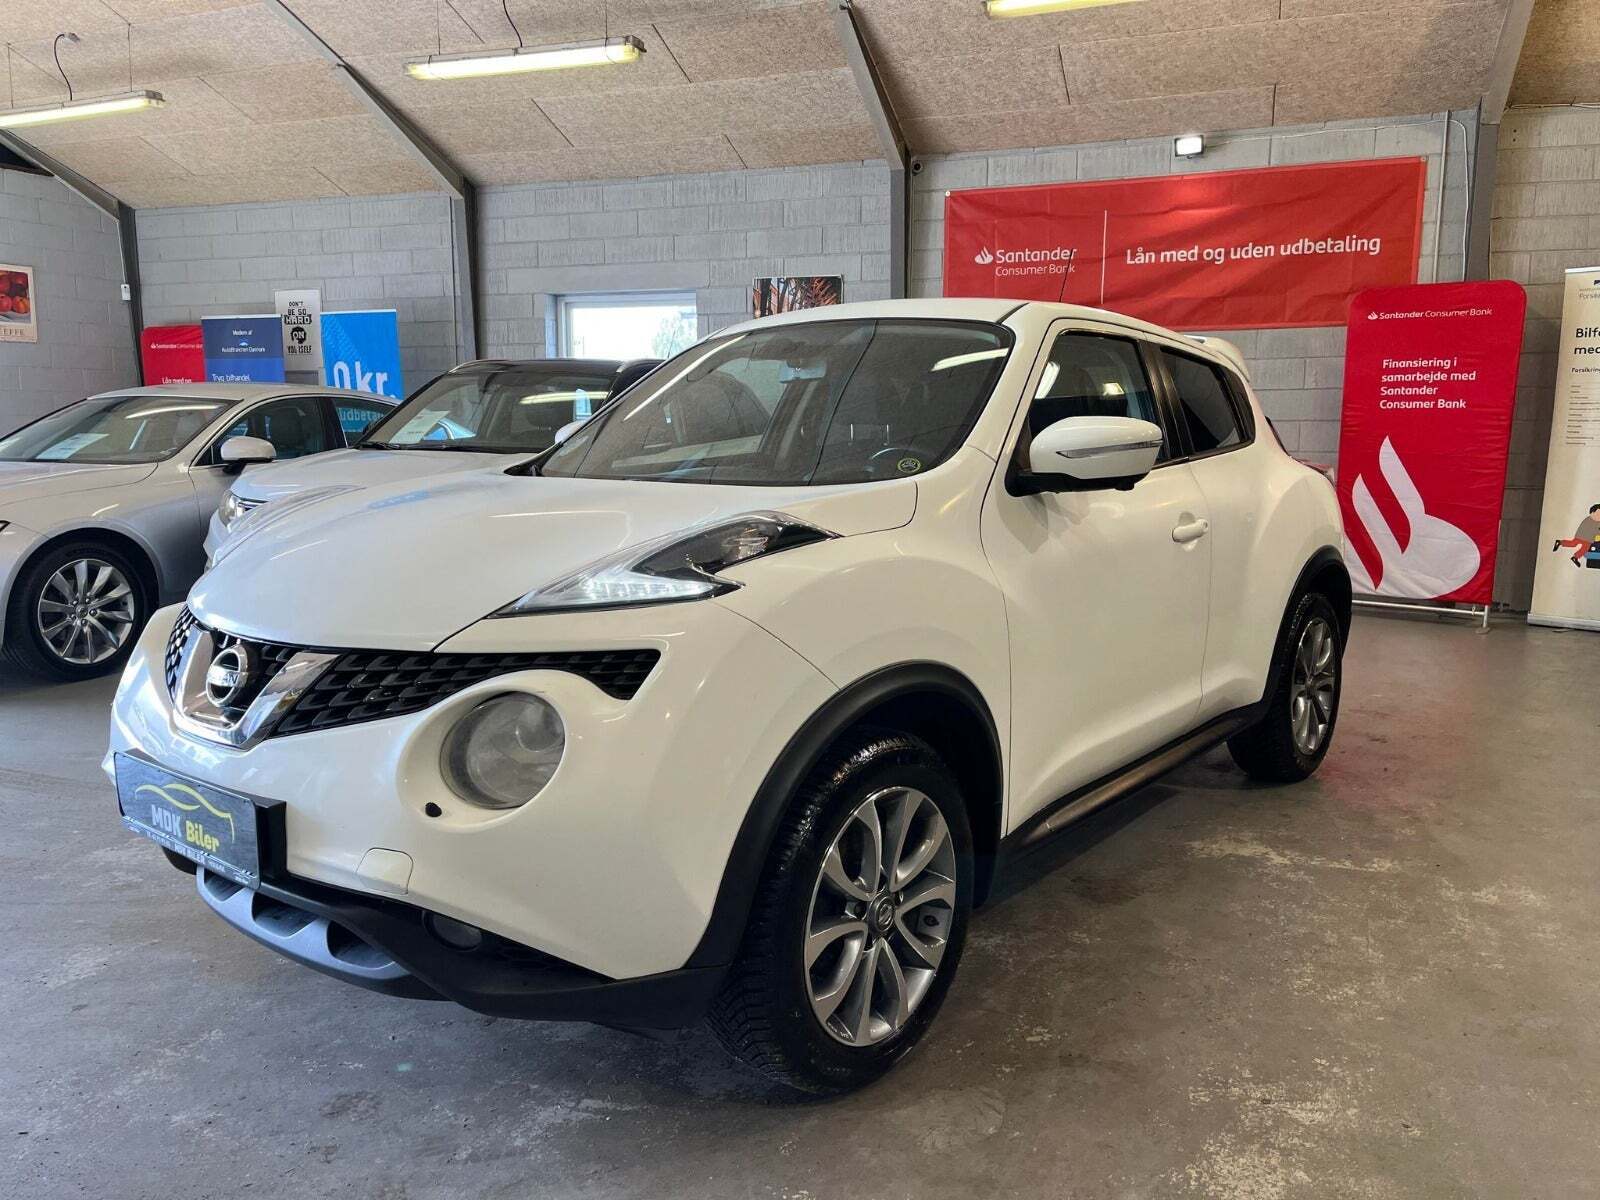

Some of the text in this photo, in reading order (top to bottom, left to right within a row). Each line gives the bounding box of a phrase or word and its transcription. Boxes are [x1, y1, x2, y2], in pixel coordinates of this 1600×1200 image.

[996, 246, 1077, 263] Santander
[1126, 234, 1382, 265] Lån med og uden udbetaling
[995, 263, 1075, 277] Consumer Bank
[285, 315, 311, 324] HARD
[1379, 308, 1493, 320] Santander Consumer Bank
[1382, 357, 1457, 369] Finansiering i
[1381, 371, 1476, 383] samarbejde med
[1380, 385, 1438, 395] Santander
[1379, 399, 1467, 409] Consumer Bank
[151, 804, 183, 838] MDK
[185, 820, 220, 853] Biler
